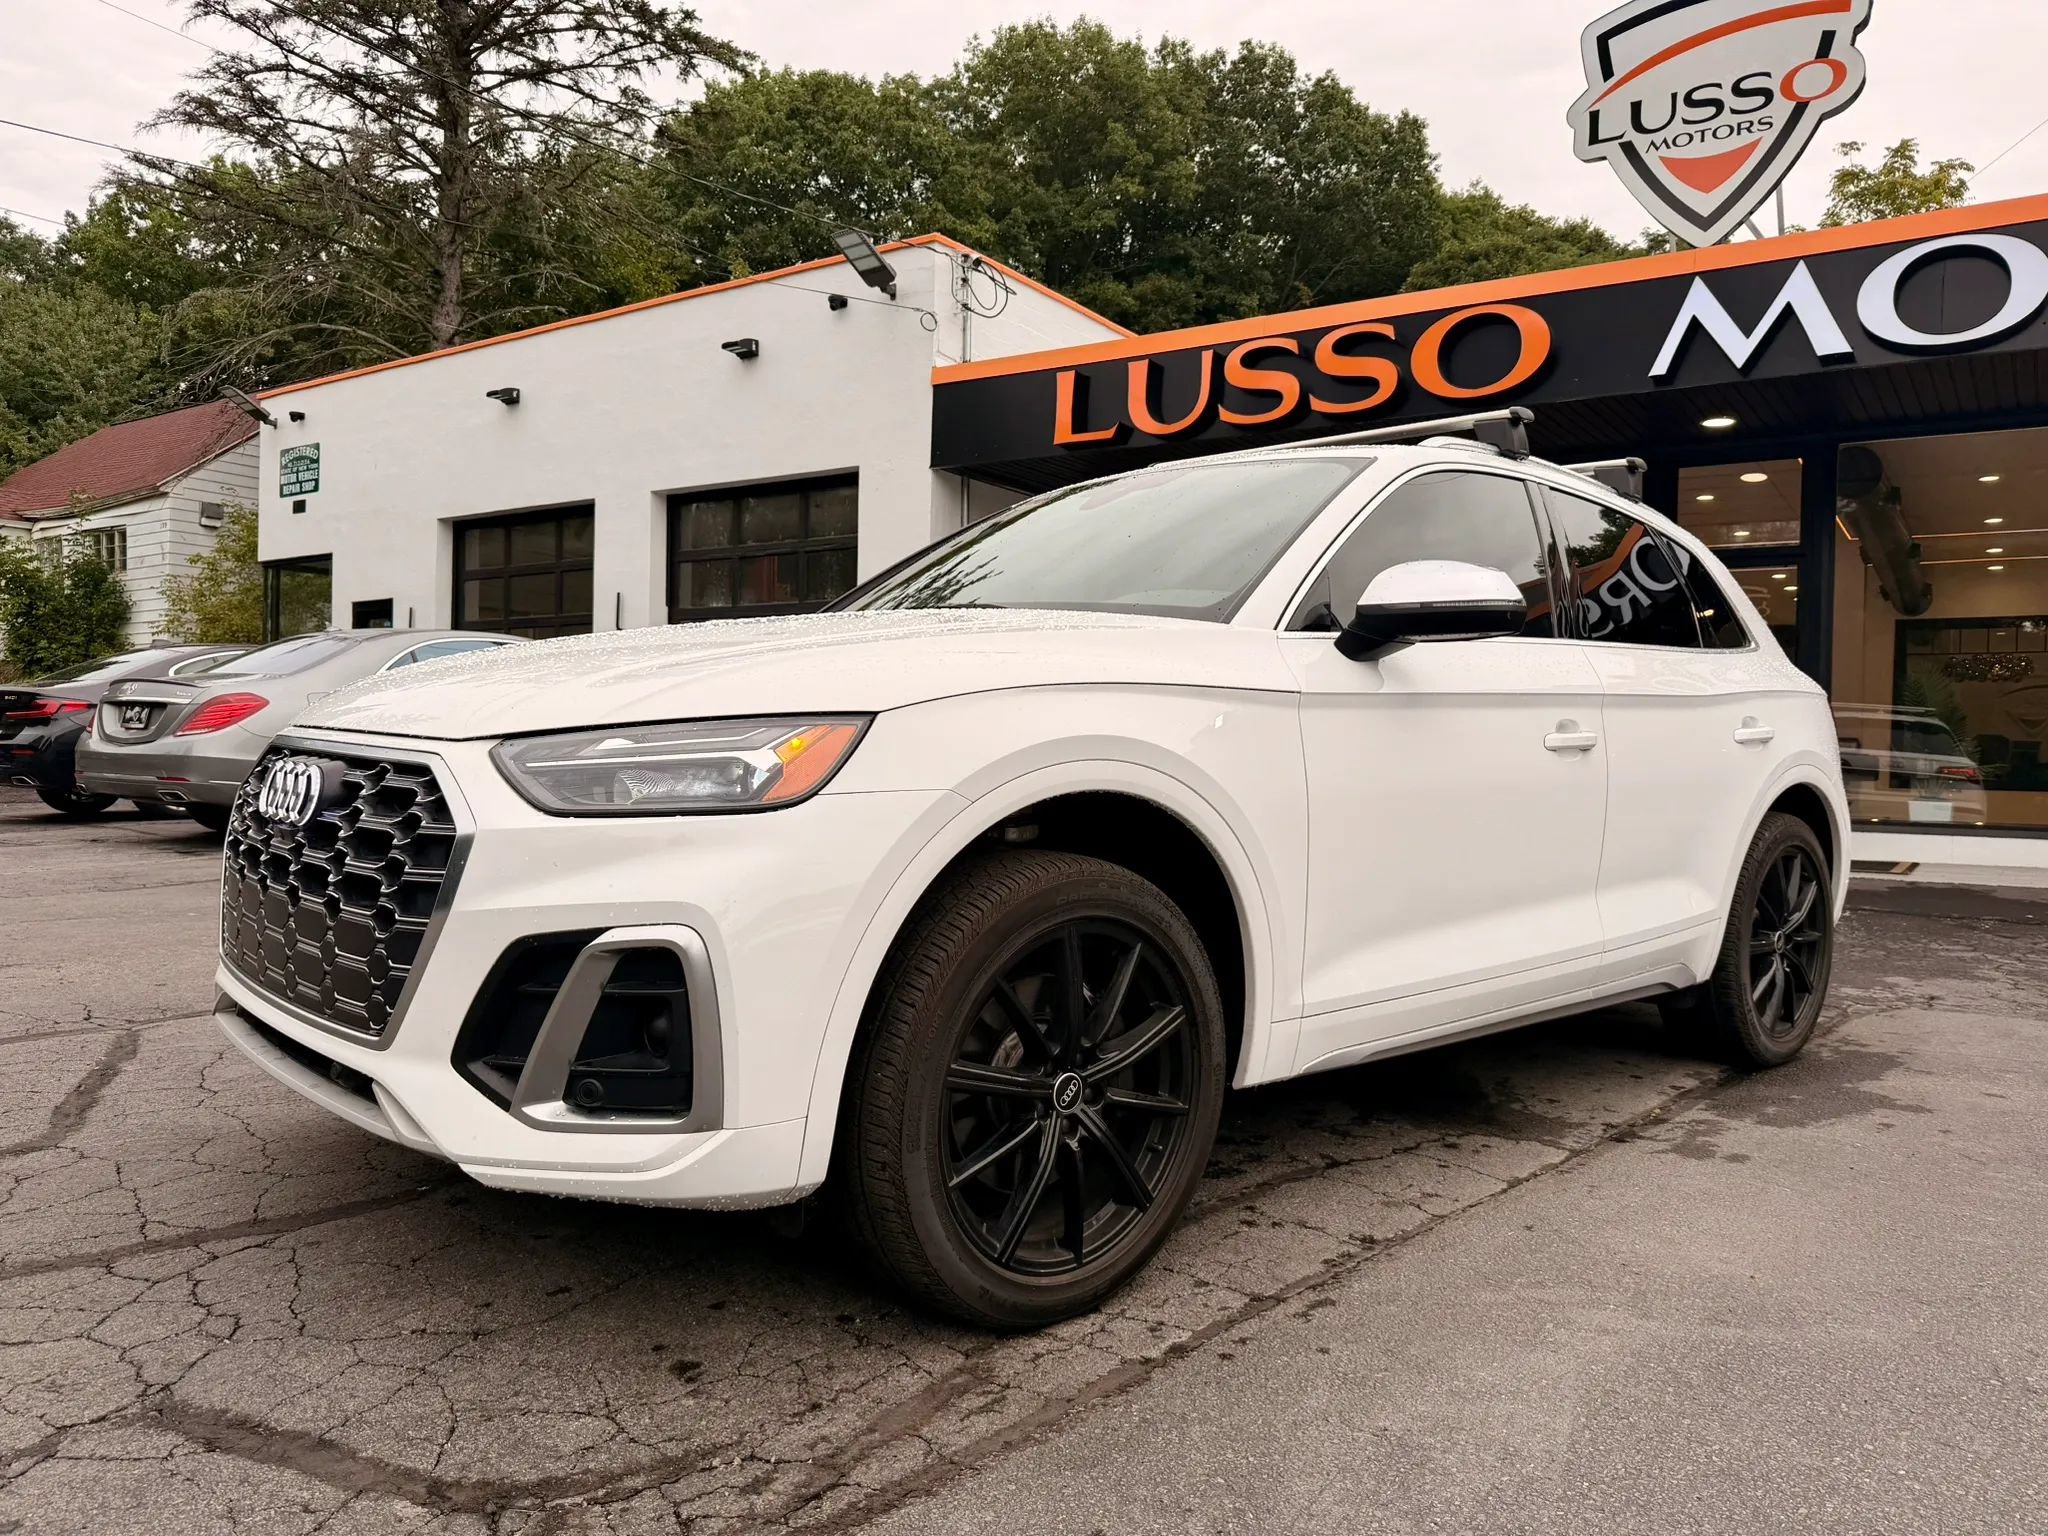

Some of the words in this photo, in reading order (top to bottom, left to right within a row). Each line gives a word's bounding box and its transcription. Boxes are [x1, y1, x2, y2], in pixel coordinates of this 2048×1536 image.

[1588, 58, 1847, 146] LUSSO
[1645, 116, 1773, 154] MOTORS
[1053, 304, 1551, 446] LUSSO
[1648, 233, 2048, 376] MO
[281, 446, 319, 466] REGISTERED
[283, 483, 300, 495] REPAIR
[301, 480, 315, 492] SHOP
[298, 469, 318, 482] VEHICLE
